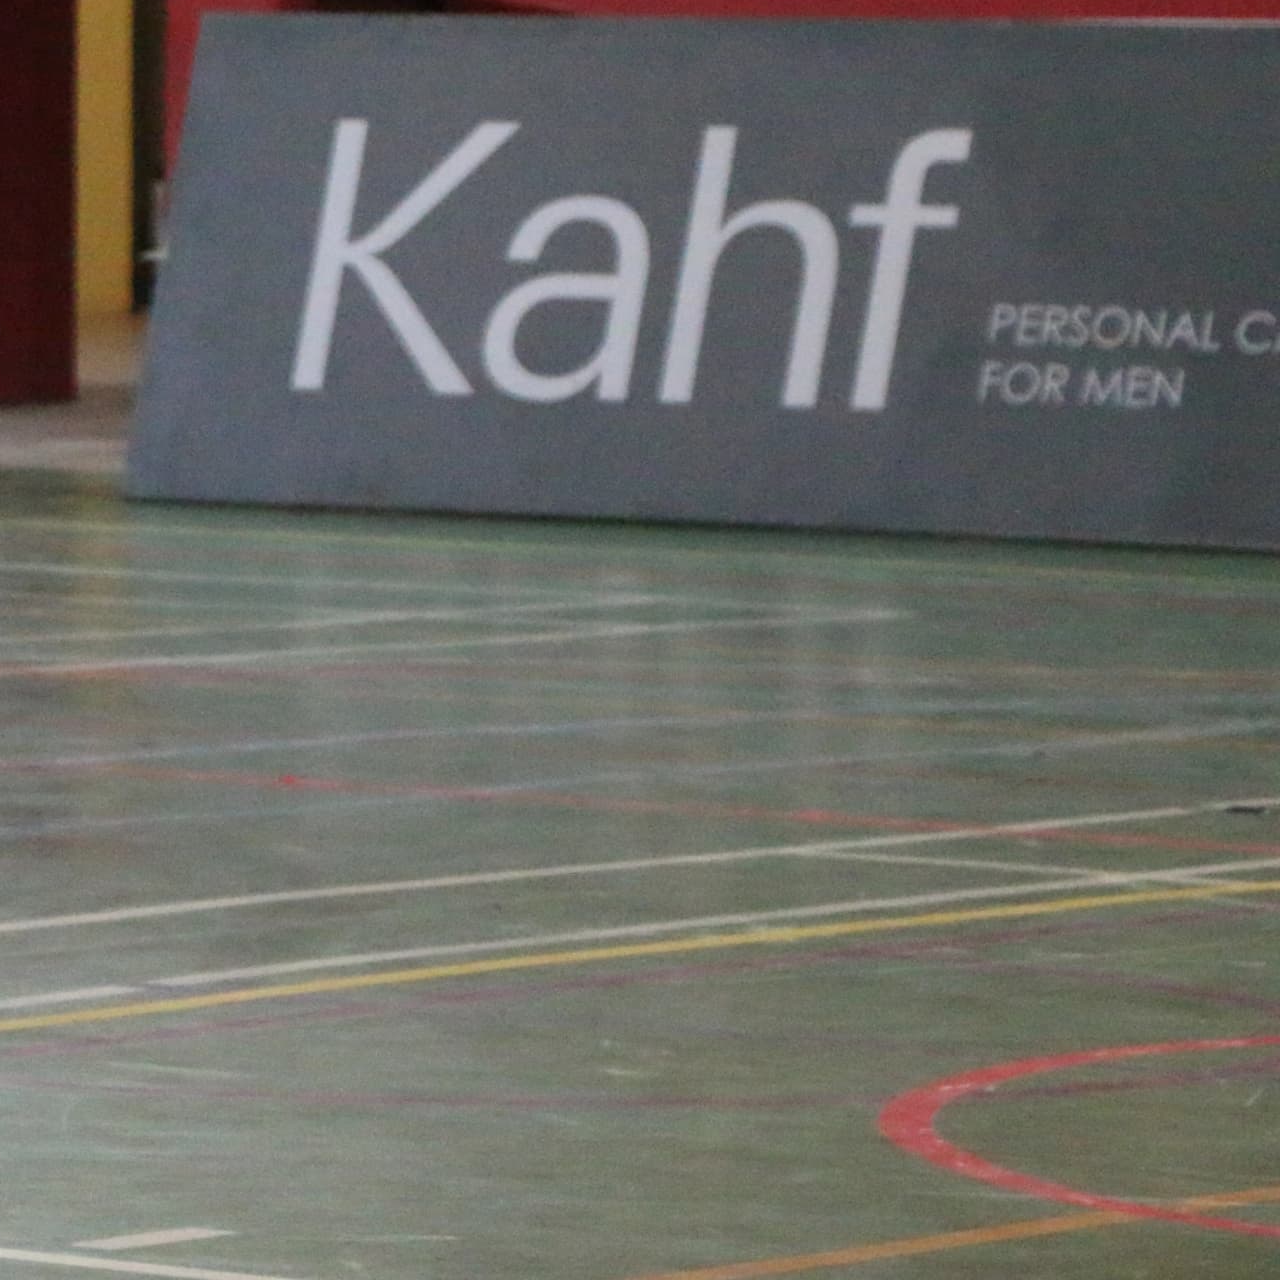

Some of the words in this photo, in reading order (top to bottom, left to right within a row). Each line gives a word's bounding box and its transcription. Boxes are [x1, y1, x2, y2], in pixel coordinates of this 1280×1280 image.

[289, 116, 976, 412] Kahf
[987, 301, 1220, 354] PERSONAL
[1234, 308, 1280, 357] C
[978, 359, 1071, 406] FOR
[1080, 366, 1186, 410] MEN
